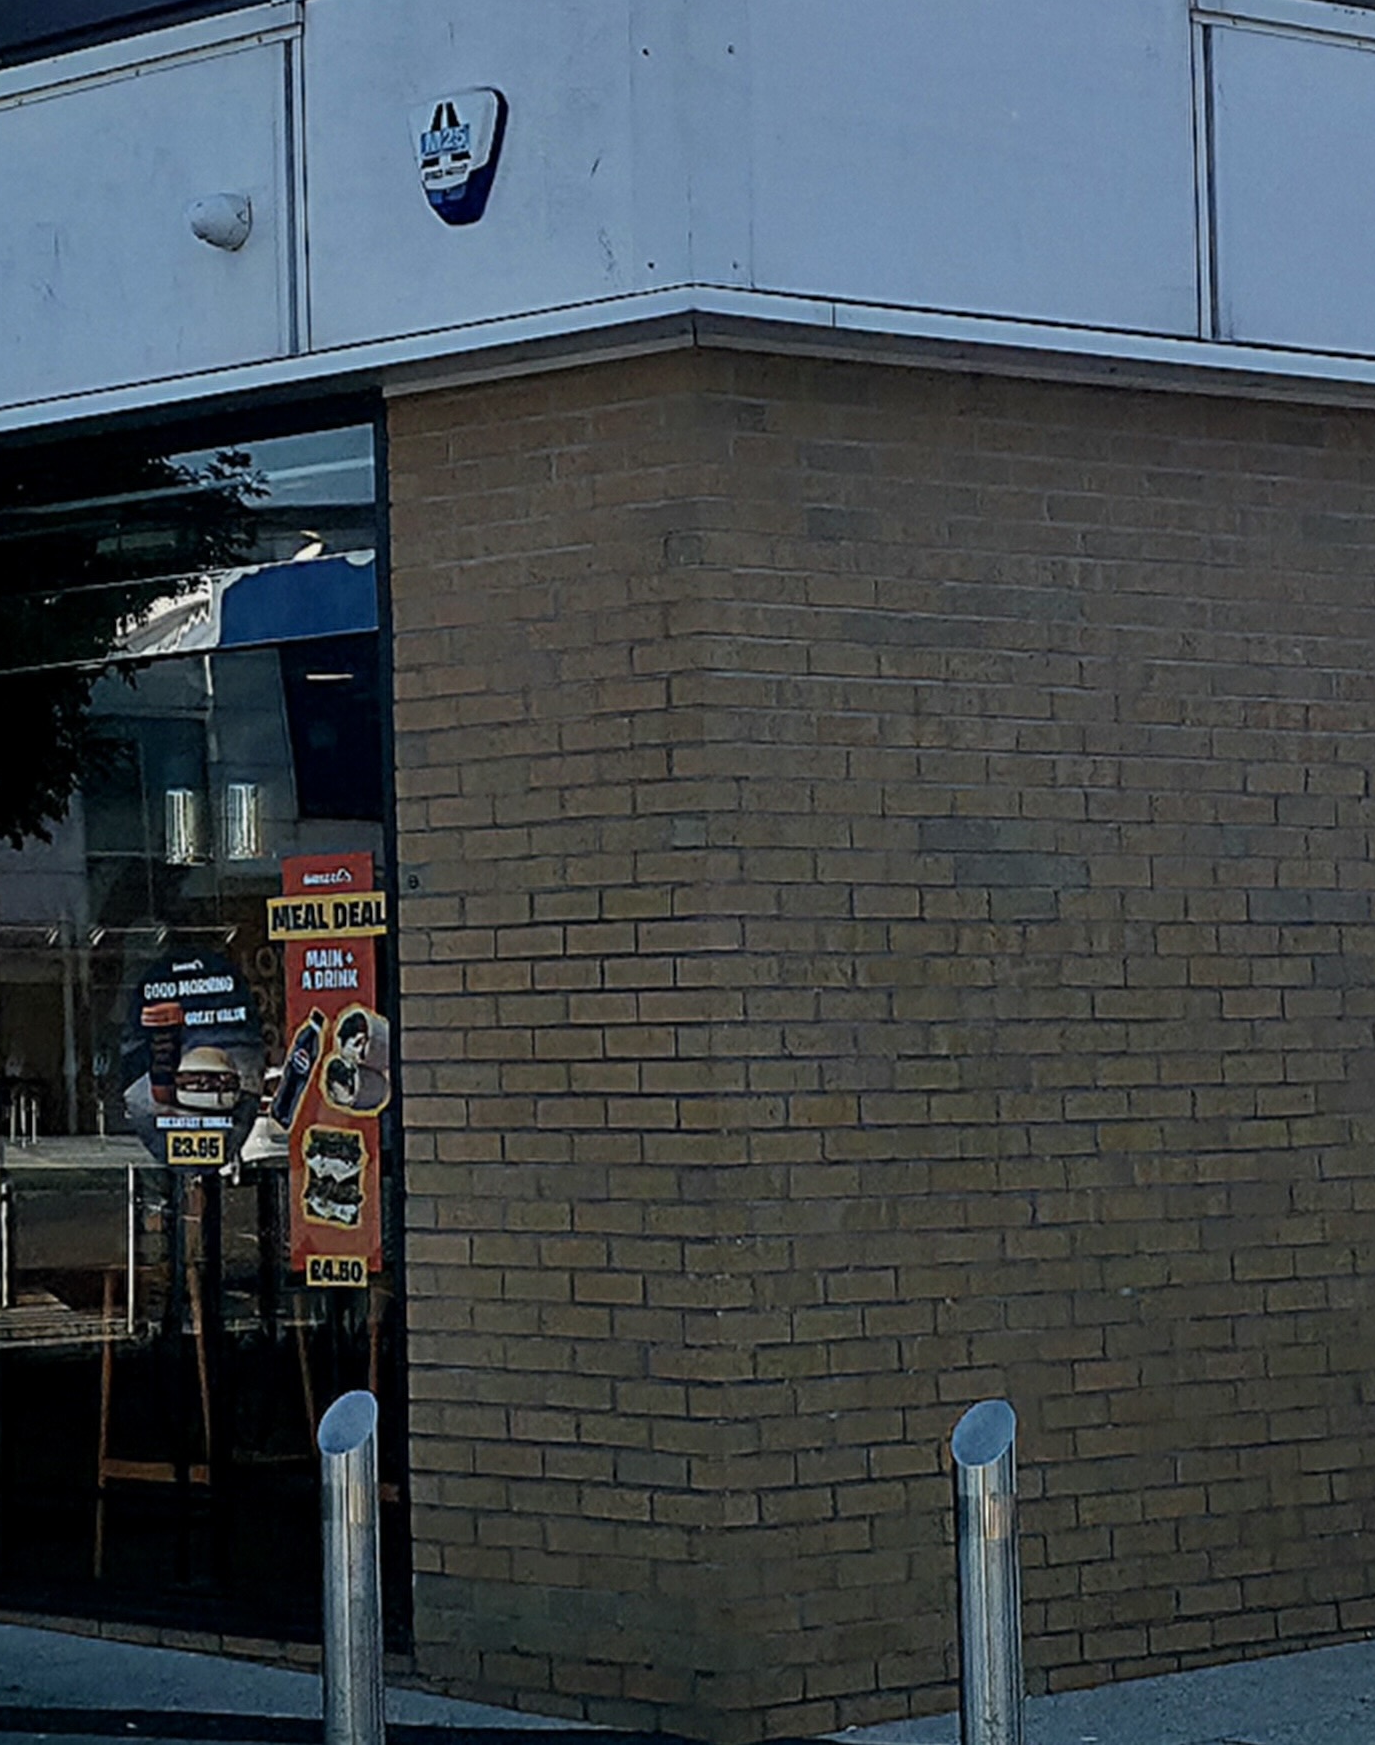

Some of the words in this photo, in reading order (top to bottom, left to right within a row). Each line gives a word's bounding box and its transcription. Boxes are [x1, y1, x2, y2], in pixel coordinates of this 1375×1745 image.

[272, 902, 330, 931] MEAL
[333, 899, 386, 928] DEAL
[306, 949, 344, 968] MAIN
[302, 970, 312, 990] A
[314, 968, 358, 989] DRINK
[144, 982, 177, 999] GOOD
